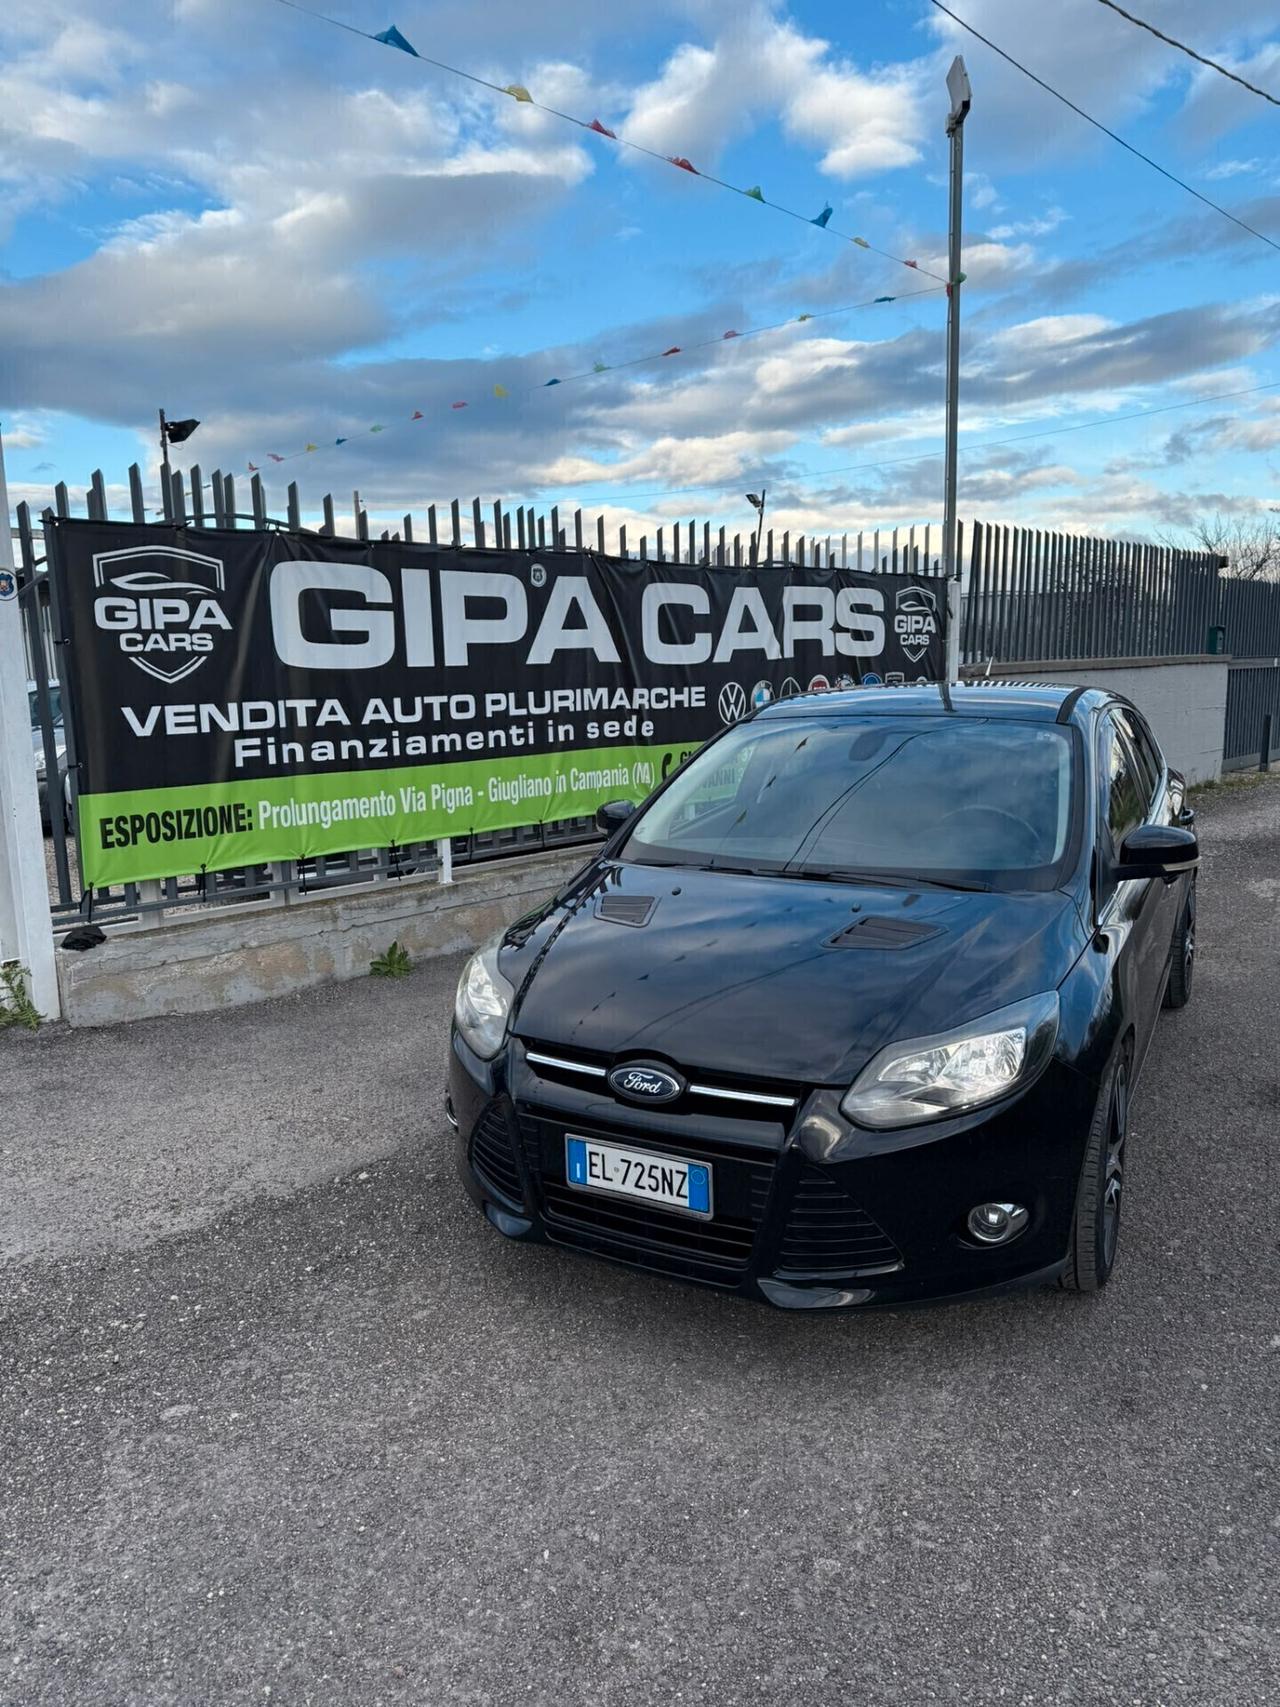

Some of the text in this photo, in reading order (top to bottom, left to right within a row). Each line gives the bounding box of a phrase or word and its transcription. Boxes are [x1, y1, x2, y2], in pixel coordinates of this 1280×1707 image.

[94, 597, 232, 630] GIPA
[269, 560, 886, 669] GIPA CARS
[894, 615, 936, 633] GIPA
[119, 632, 214, 652] CARS
[900, 634, 930, 645] CARS
[121, 686, 706, 737] VENDITA AUTO PLURIMARCHE
[234, 718, 655, 767] Finanziamenti in sede
[100, 802, 254, 849] ESPOSIZIONE:
[258, 790, 396, 830] Prolungamento
[400, 785, 426, 814] Via
[431, 783, 473, 814] Pigna
[488, 772, 551, 805] Giugliano
[555, 770, 567, 793] in
[570, 763, 629, 794] Campania
[624, 1071, 662, 1094] Ford
